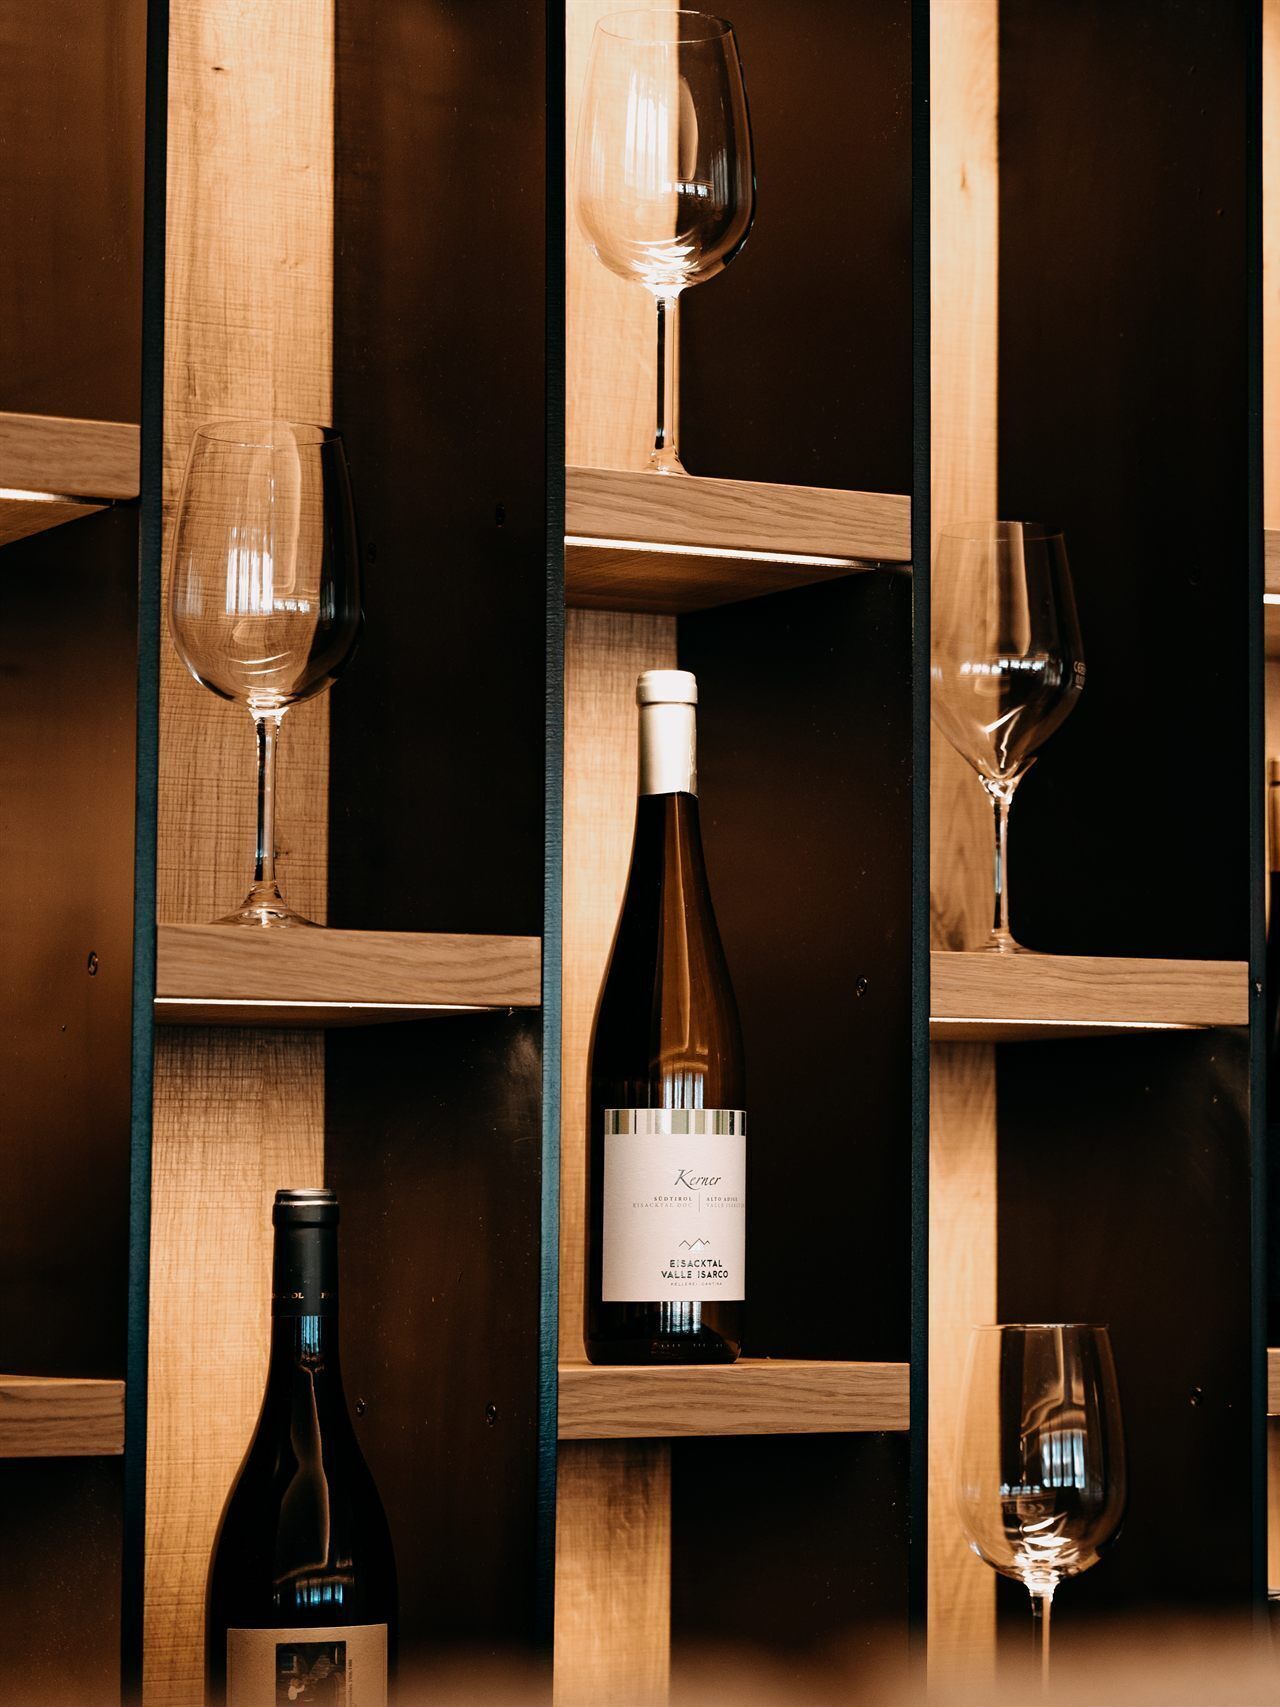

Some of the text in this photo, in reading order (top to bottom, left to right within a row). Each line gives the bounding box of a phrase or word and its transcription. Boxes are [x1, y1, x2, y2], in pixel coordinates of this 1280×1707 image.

[674, 1169, 722, 1190] Kerner
[669, 1259, 723, 1268] EISACKTAL
[660, 1270, 729, 1279] VALLE ISARCO
